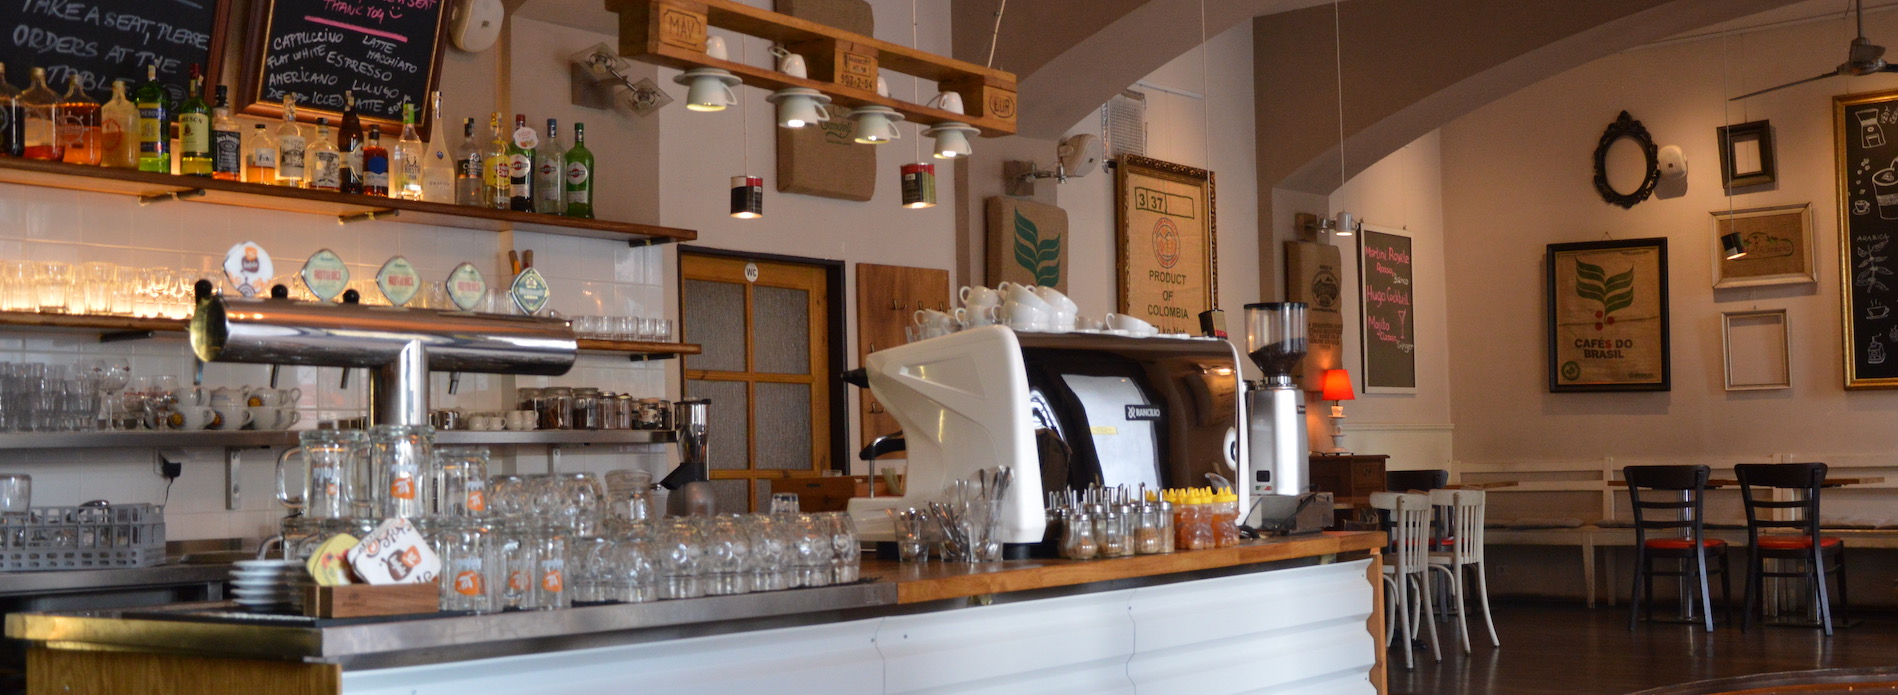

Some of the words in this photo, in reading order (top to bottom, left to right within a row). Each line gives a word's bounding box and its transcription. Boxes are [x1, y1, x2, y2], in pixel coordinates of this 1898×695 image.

[84, 6, 100, 26] A
[13, 24, 99, 57] ORDERS
[273, 28, 344, 51] CAPPUCCINO
[362, 35, 396, 54] LATTE
[105, 45, 134, 64] AT
[267, 53, 289, 69] FLAT
[293, 44, 327, 60] WHITE
[366, 50, 418, 73] MACCHIATO
[326, 51, 392, 82] ESPRESSO
[268, 66, 338, 86] AMERICANO
[352, 79, 399, 99] LUNGO
[354, 98, 385, 112] ATTE
[1139, 193, 1146, 206] 3
[1151, 195, 1163, 210] 37
[1365, 246, 1387, 261] Martini
[746, 268, 757, 277] WC
[1149, 269, 1186, 285] PRODUCT
[1162, 290, 1173, 301] OF
[1366, 285, 1386, 307] Hugo
[1386, 286, 1410, 305] Cocktail
[1147, 304, 1189, 319] COLOMBIA
[1368, 315, 1390, 332] Mojito
[1574, 336, 1612, 349] CAFÉS
[1615, 338, 1633, 349] DO
[1583, 349, 1625, 359] BRASIL
[1136, 408, 1160, 417] RANCILIO
